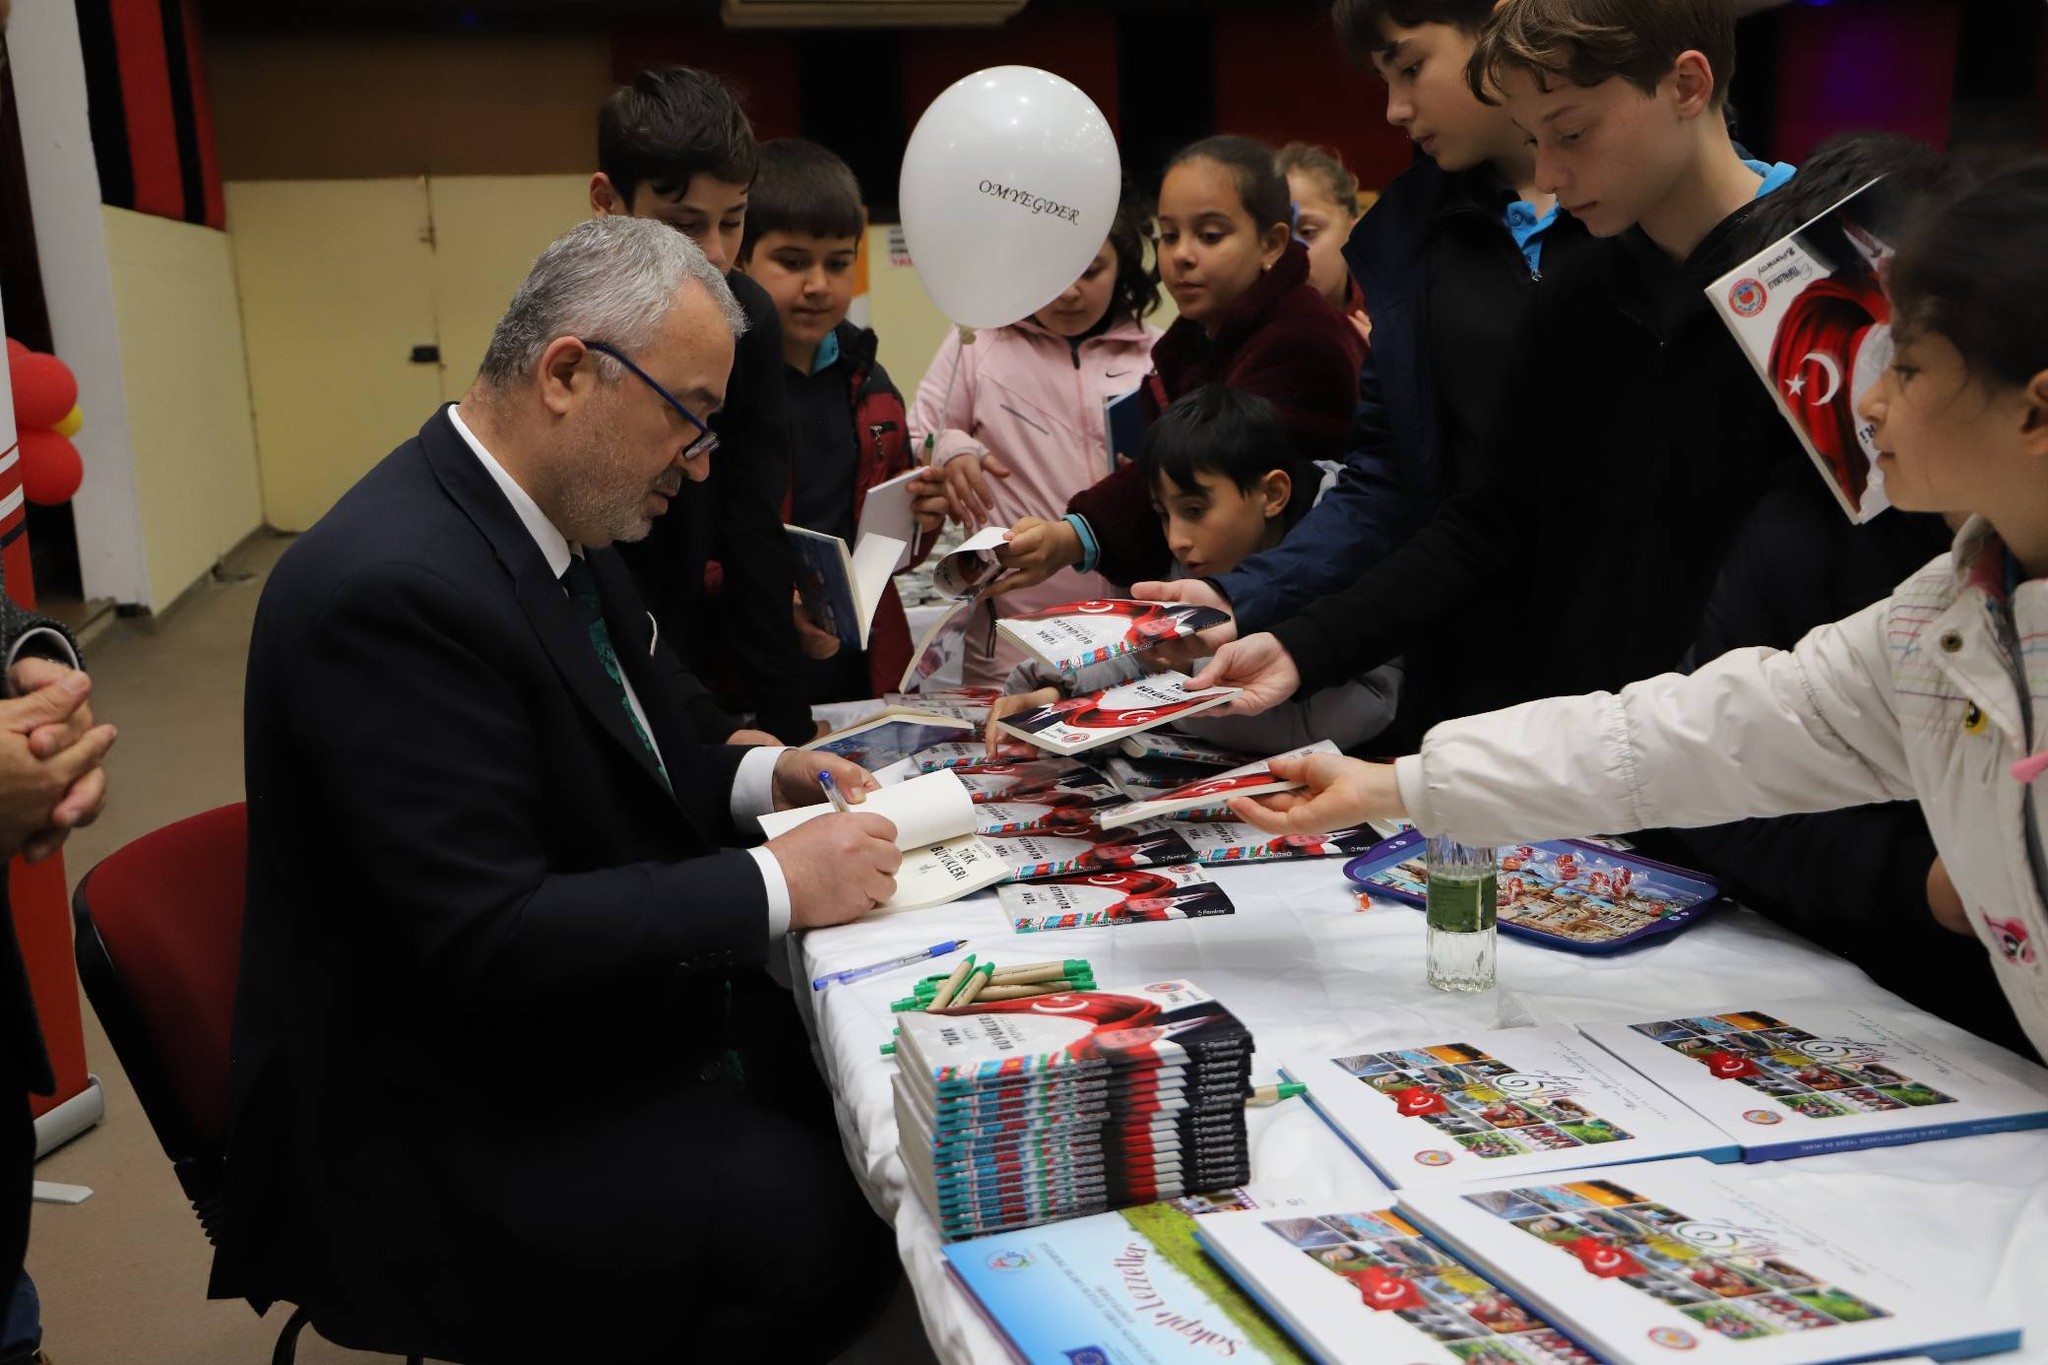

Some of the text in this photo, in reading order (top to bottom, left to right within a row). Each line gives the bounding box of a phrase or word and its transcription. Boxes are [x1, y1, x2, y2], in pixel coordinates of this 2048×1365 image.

[978, 179, 1080, 226] OMYEGDER
[930, 845, 969, 882] BÜYÜKLERİ
[957, 847, 980, 866] TÜRK
